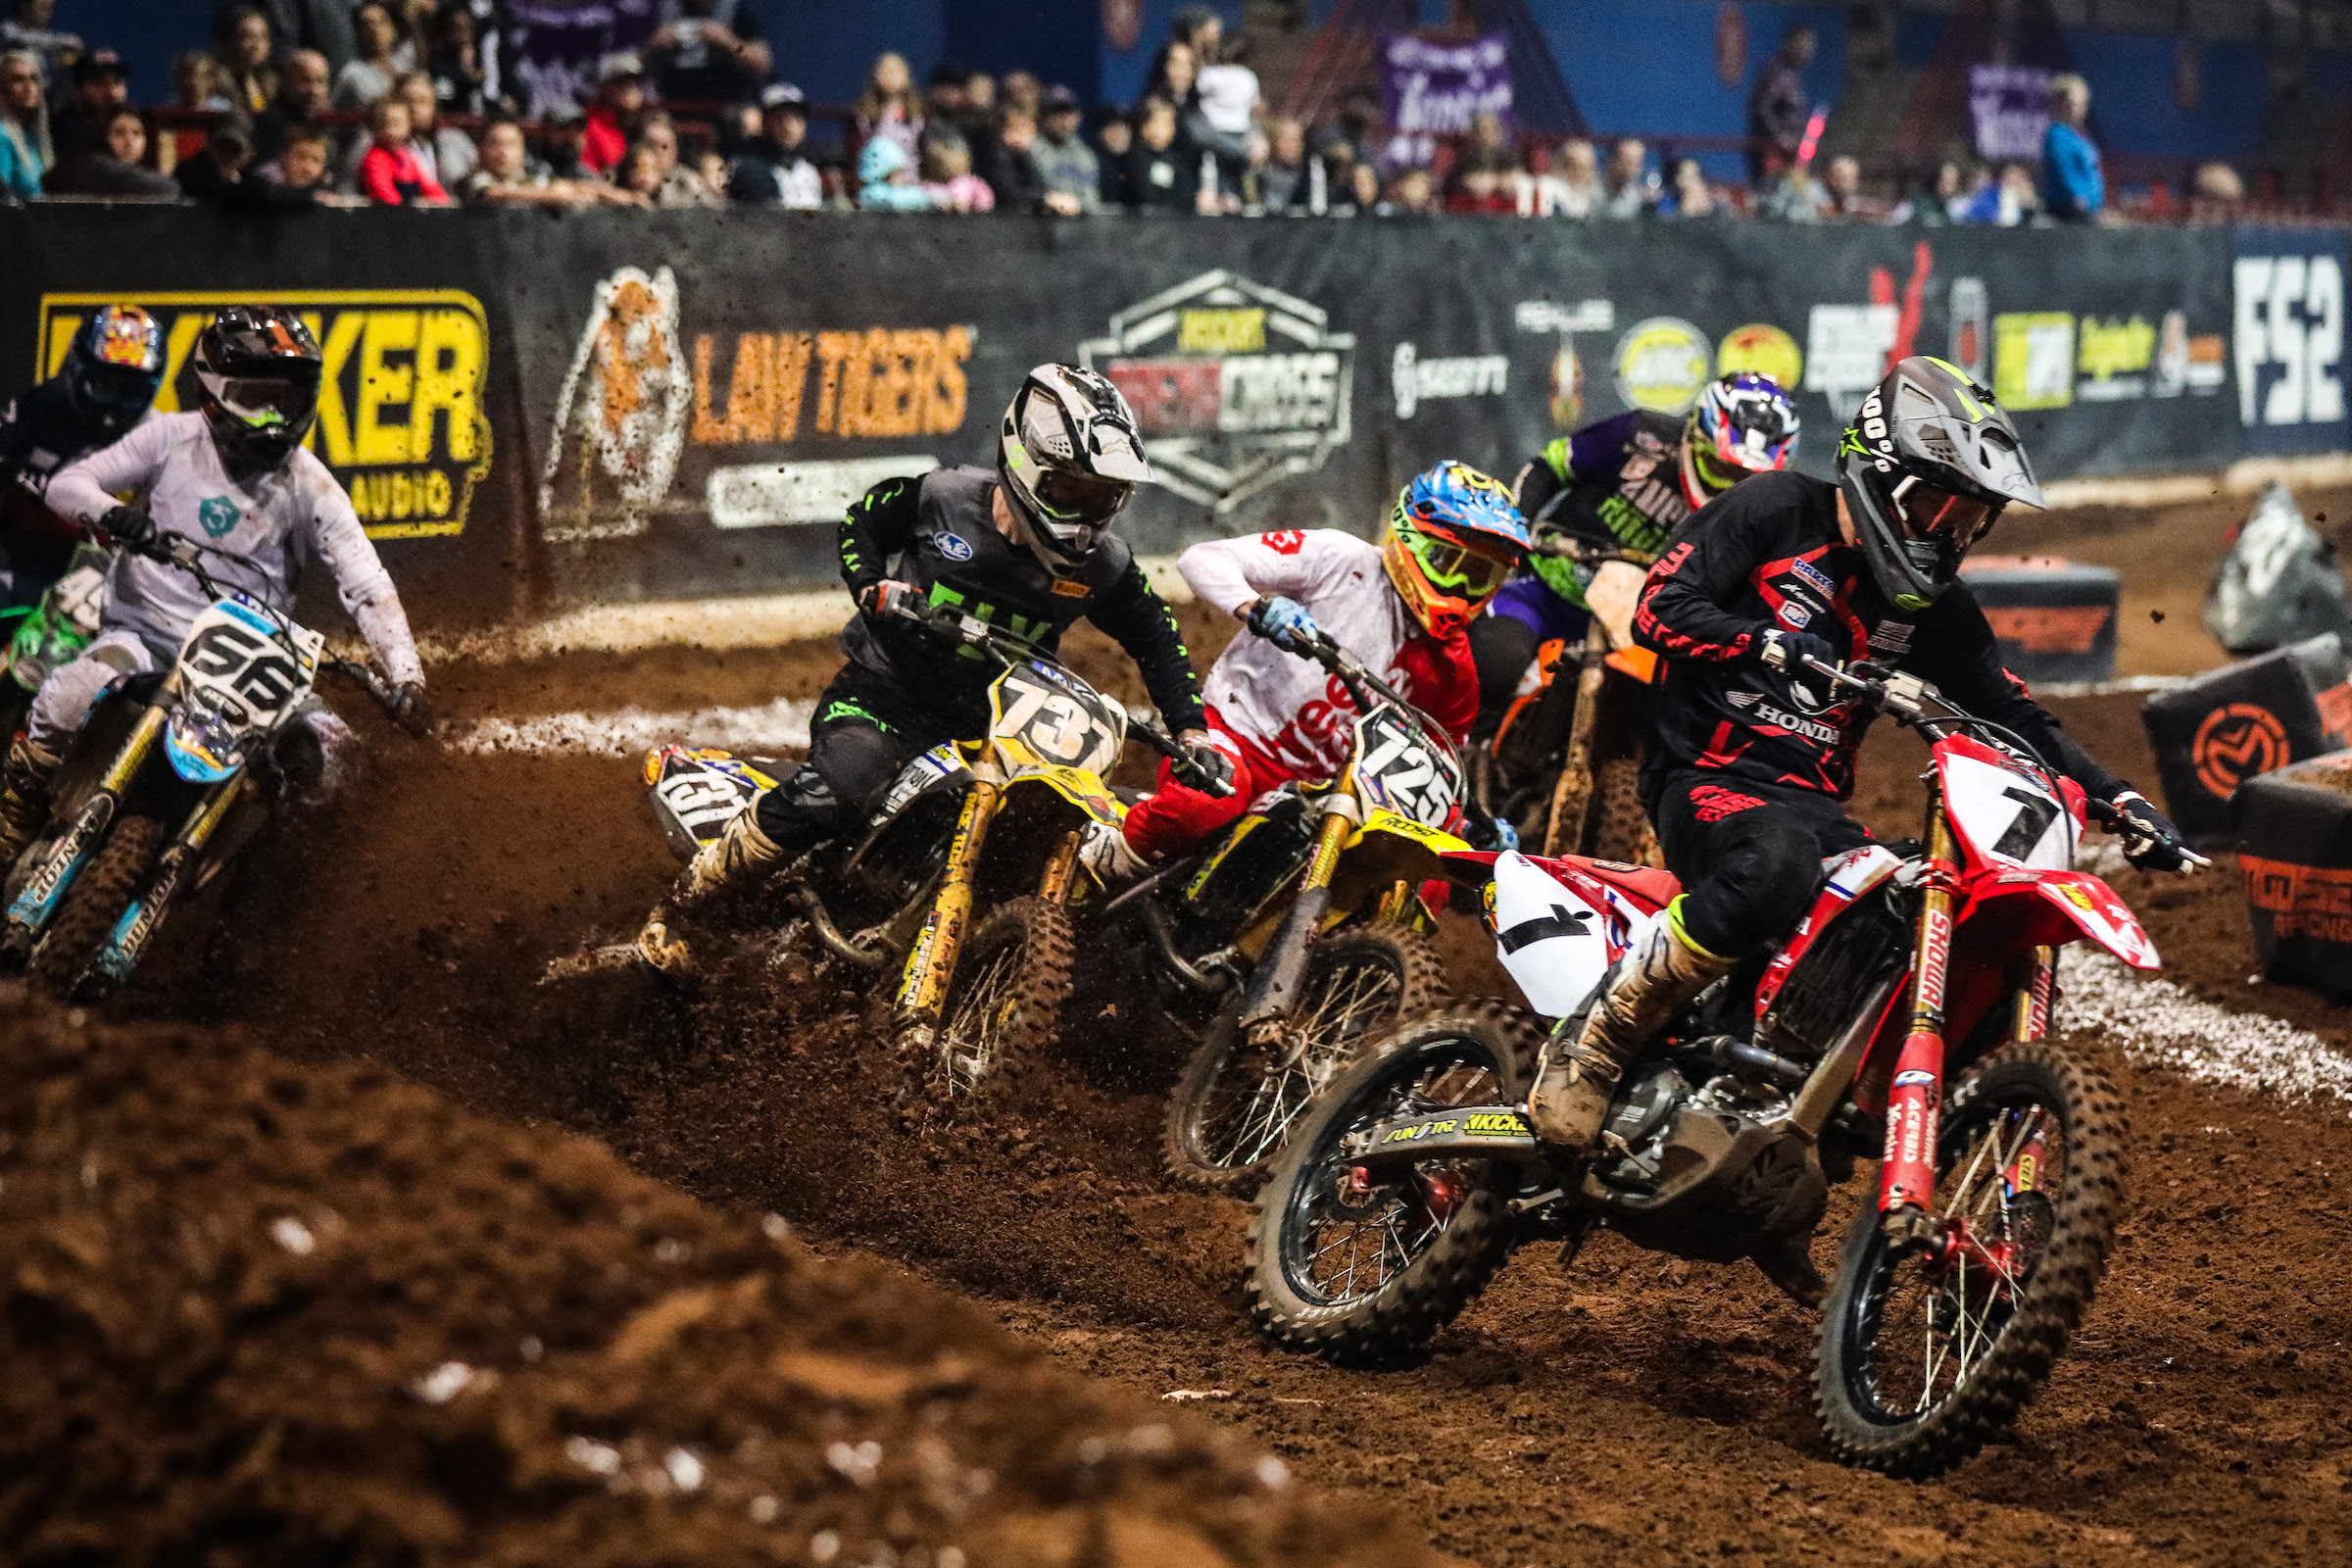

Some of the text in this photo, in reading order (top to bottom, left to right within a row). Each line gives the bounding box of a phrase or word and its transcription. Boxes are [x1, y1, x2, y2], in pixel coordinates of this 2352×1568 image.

[49, 311, 481, 465] KER
[691, 324, 972, 441] LAW TIGERS
[2233, 256, 2343, 426] FS2
[351, 470, 452, 520] AUDIO
[1361, 718, 1457, 829] 725
[1918, 911, 1951, 1010] SHOWA
